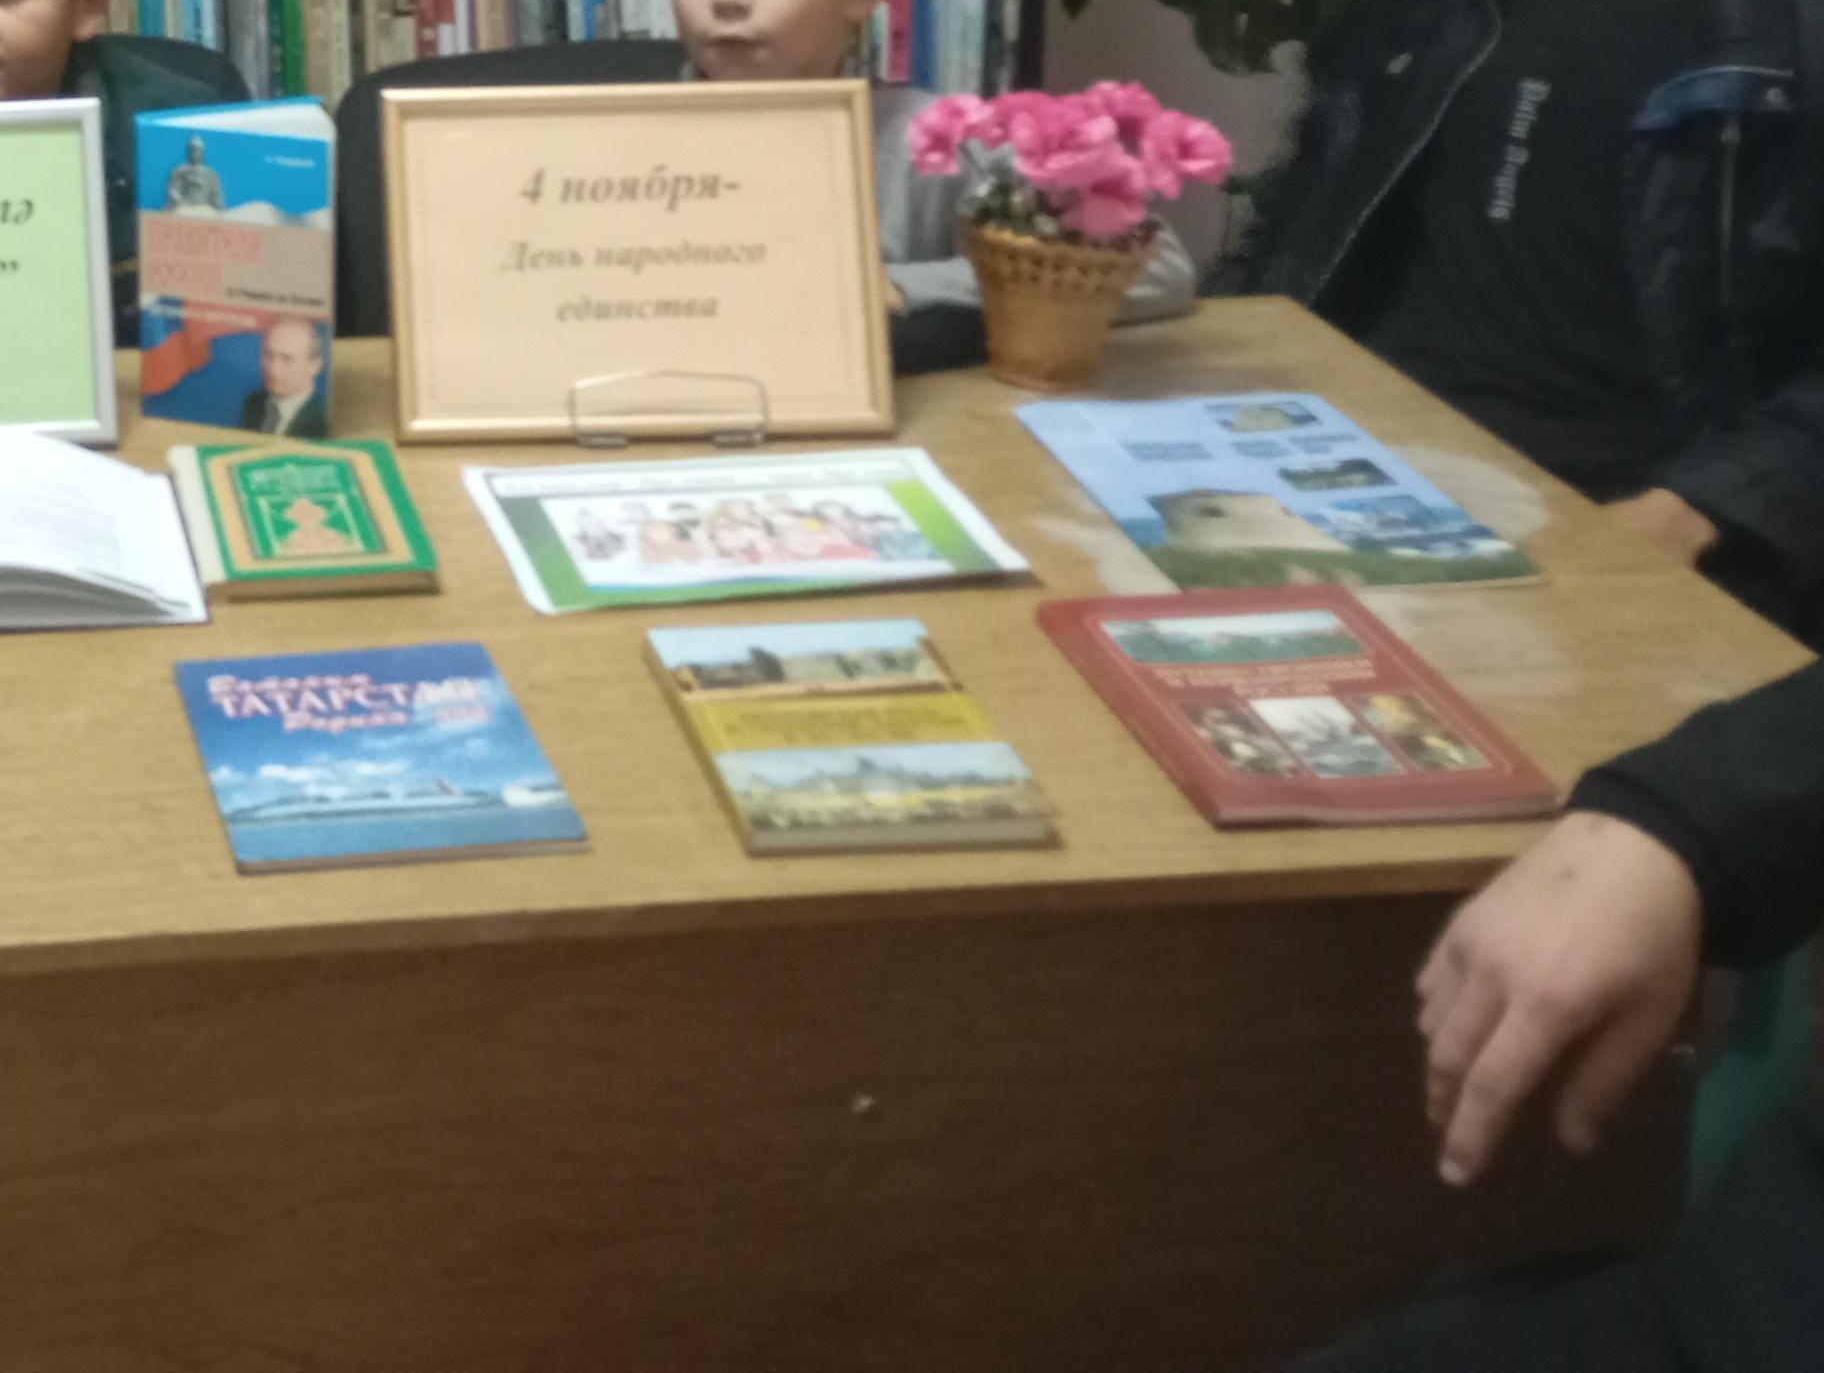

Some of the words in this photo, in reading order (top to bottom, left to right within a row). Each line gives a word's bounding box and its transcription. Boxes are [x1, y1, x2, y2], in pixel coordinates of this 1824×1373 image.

[519, 165, 547, 207] 4
[559, 162, 744, 214] ноября-
[499, 239, 584, 274] День
[593, 239, 768, 277] народного
[555, 295, 721, 323] единства
